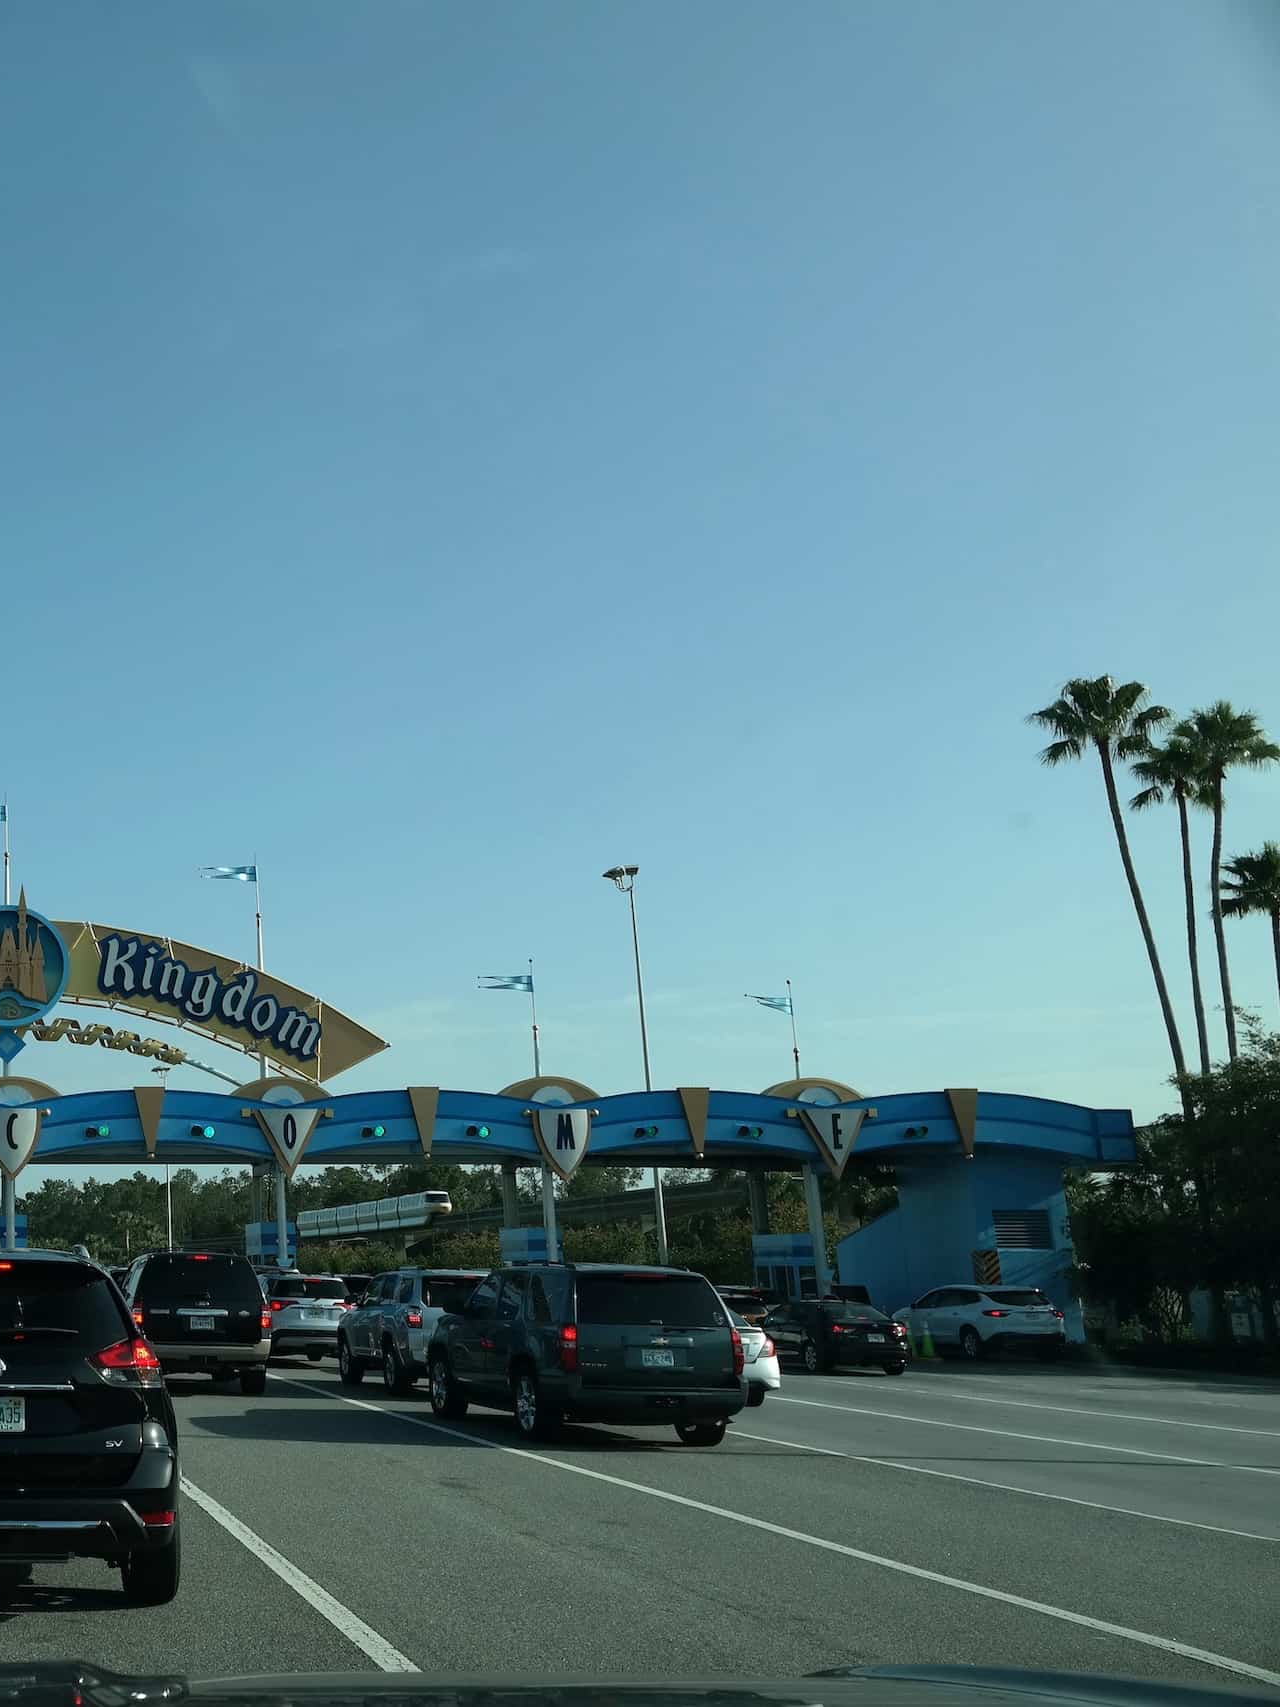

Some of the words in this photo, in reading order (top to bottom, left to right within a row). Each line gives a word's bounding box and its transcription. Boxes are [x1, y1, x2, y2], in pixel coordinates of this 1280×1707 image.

[100, 934, 322, 1060] Kingdom
[6, 1112, 19, 1150] C
[283, 1113, 297, 1149] O
[556, 1113, 576, 1150] M
[832, 1113, 843, 1150] E
[104, 1439, 124, 1448] SV
